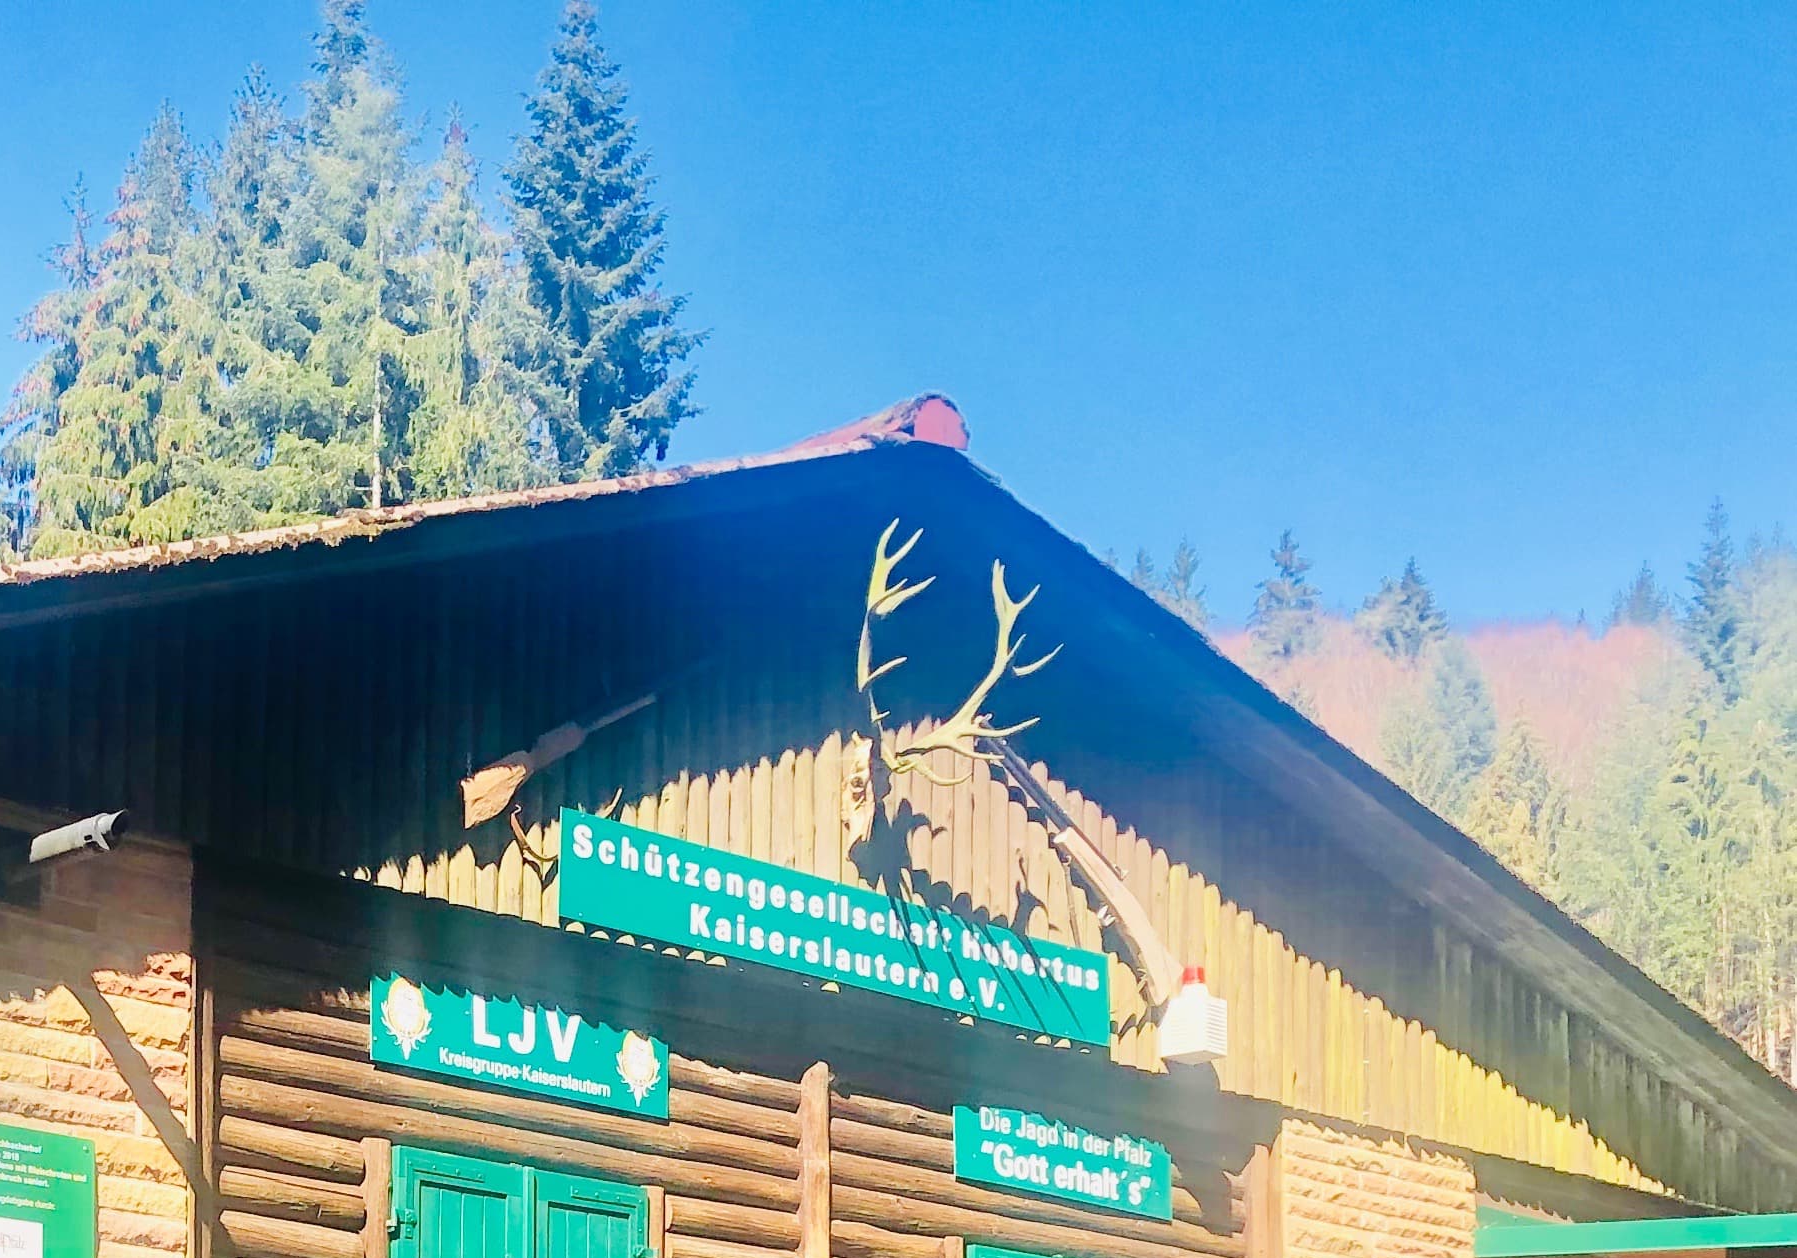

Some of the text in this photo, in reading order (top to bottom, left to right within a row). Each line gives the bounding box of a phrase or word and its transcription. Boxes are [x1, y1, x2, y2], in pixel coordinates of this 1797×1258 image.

[571, 823, 1100, 992] Schützengesellschaft Hubertus
[688, 902, 940, 995] Kaiserslautern
[472, 994, 582, 1063] LJV
[979, 1106, 1152, 1168] Die Jagd in der Pfalz
